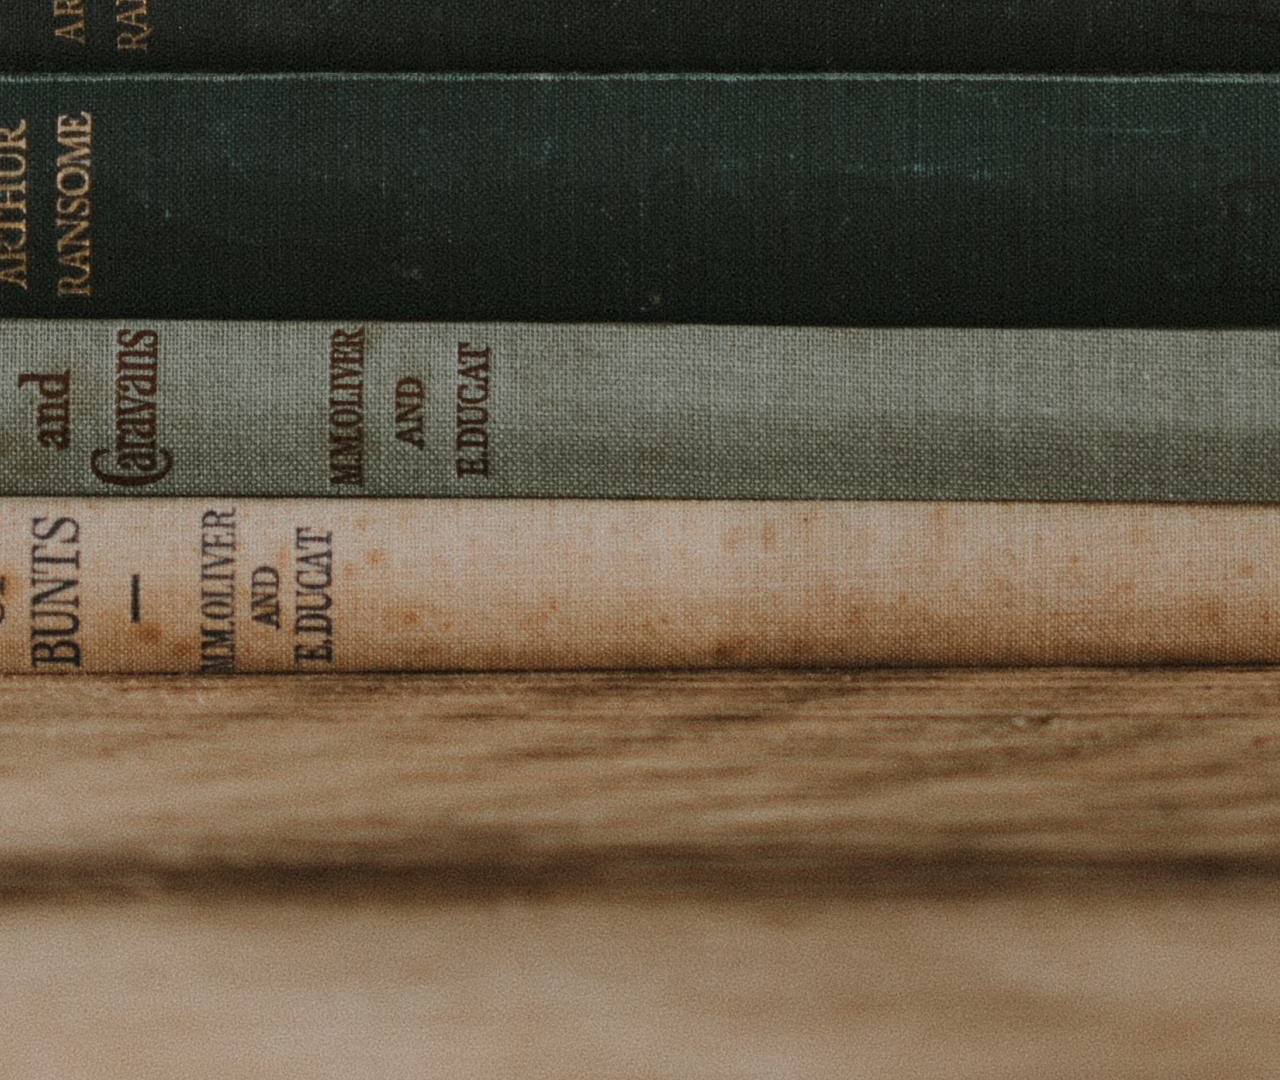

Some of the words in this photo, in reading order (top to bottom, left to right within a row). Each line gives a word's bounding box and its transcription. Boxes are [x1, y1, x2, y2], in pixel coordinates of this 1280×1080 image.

[57, 111, 92, 296] RANSOME
[18, 369, 70, 450] and
[90, 329, 172, 487] Caravans
[395, 376, 424, 450] AND
[457, 342, 489, 478] E.DUCAT
[30, 517, 80, 667] BUNTS
[251, 566, 280, 629] AND
[295, 527, 332, 663] E.DUCAT
